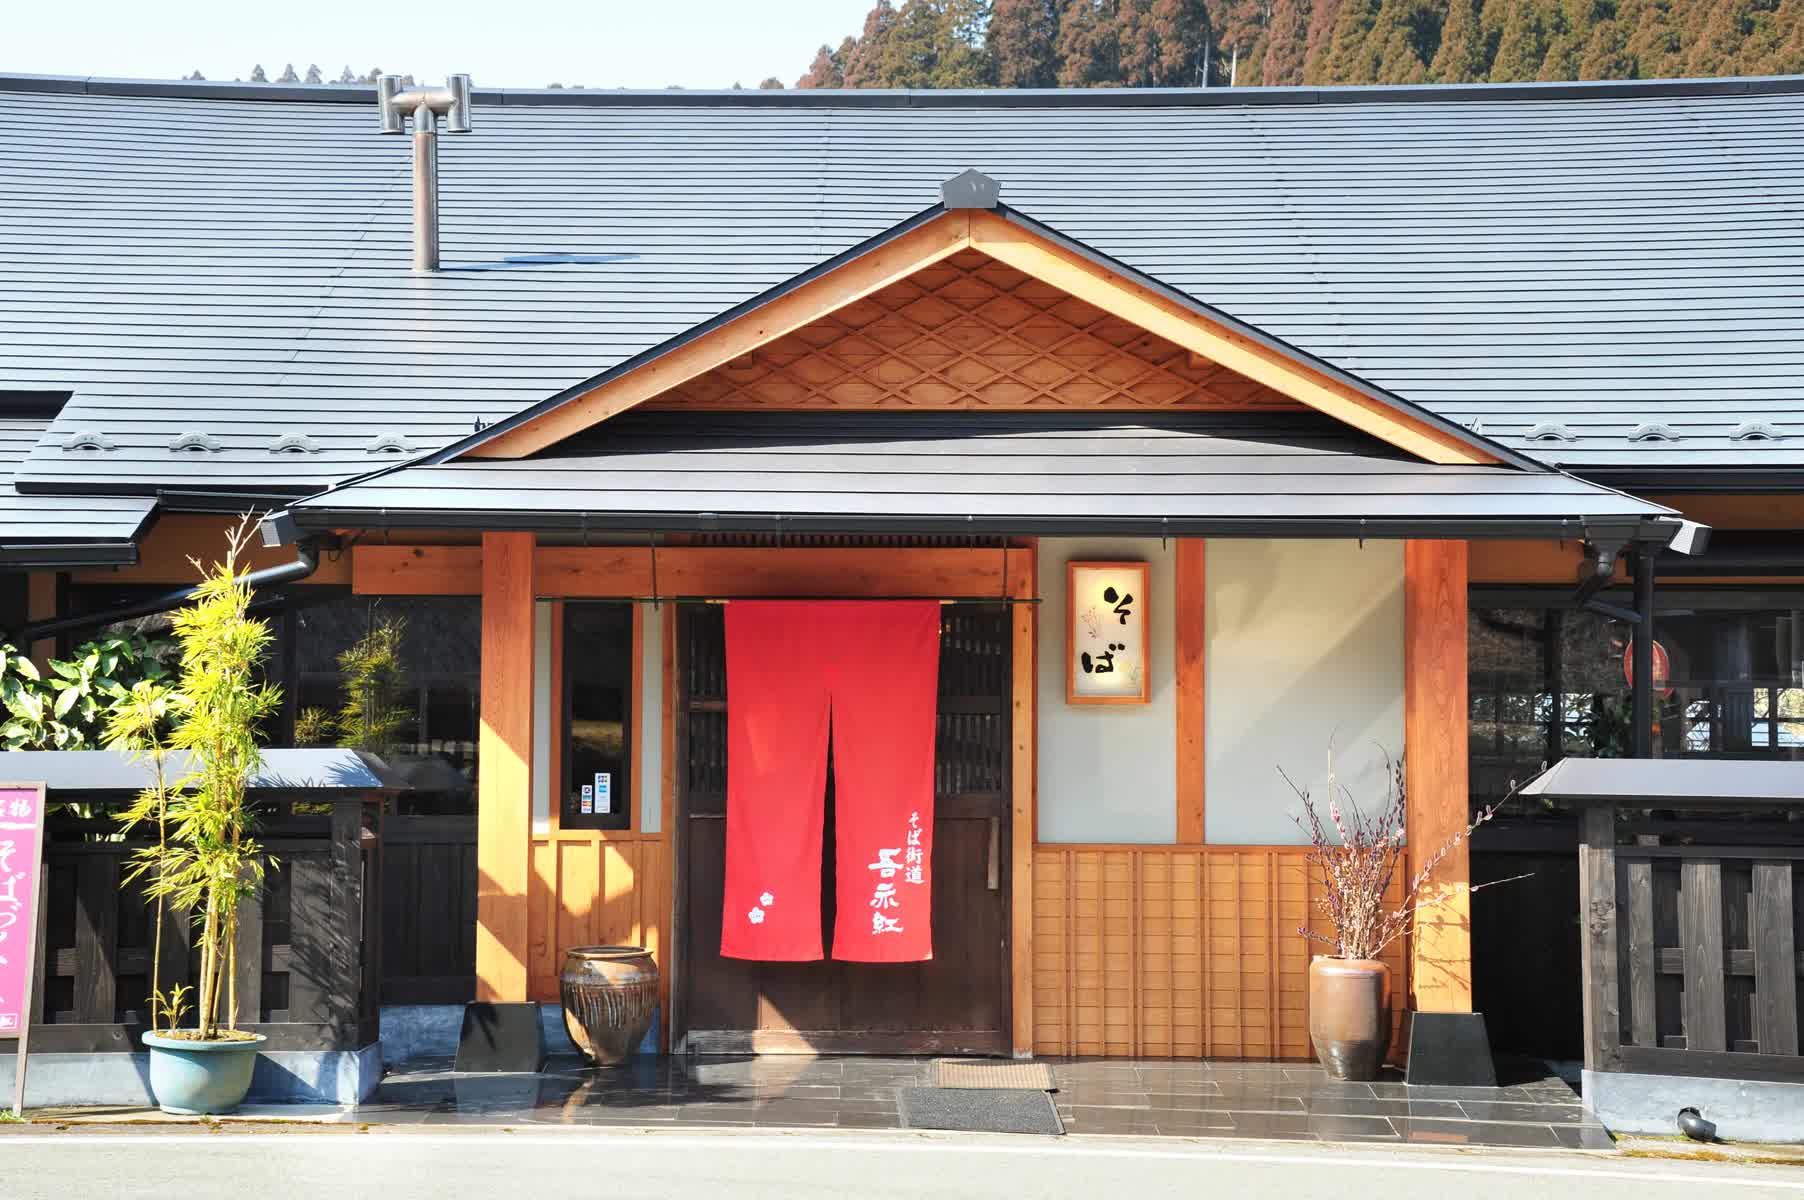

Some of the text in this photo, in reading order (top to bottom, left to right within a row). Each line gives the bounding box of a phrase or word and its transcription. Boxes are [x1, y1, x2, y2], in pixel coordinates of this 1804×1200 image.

[1081, 587, 1134, 674] そば
[904, 811, 925, 884] そば街道
[867, 848, 904, 935] 吾亦紅
